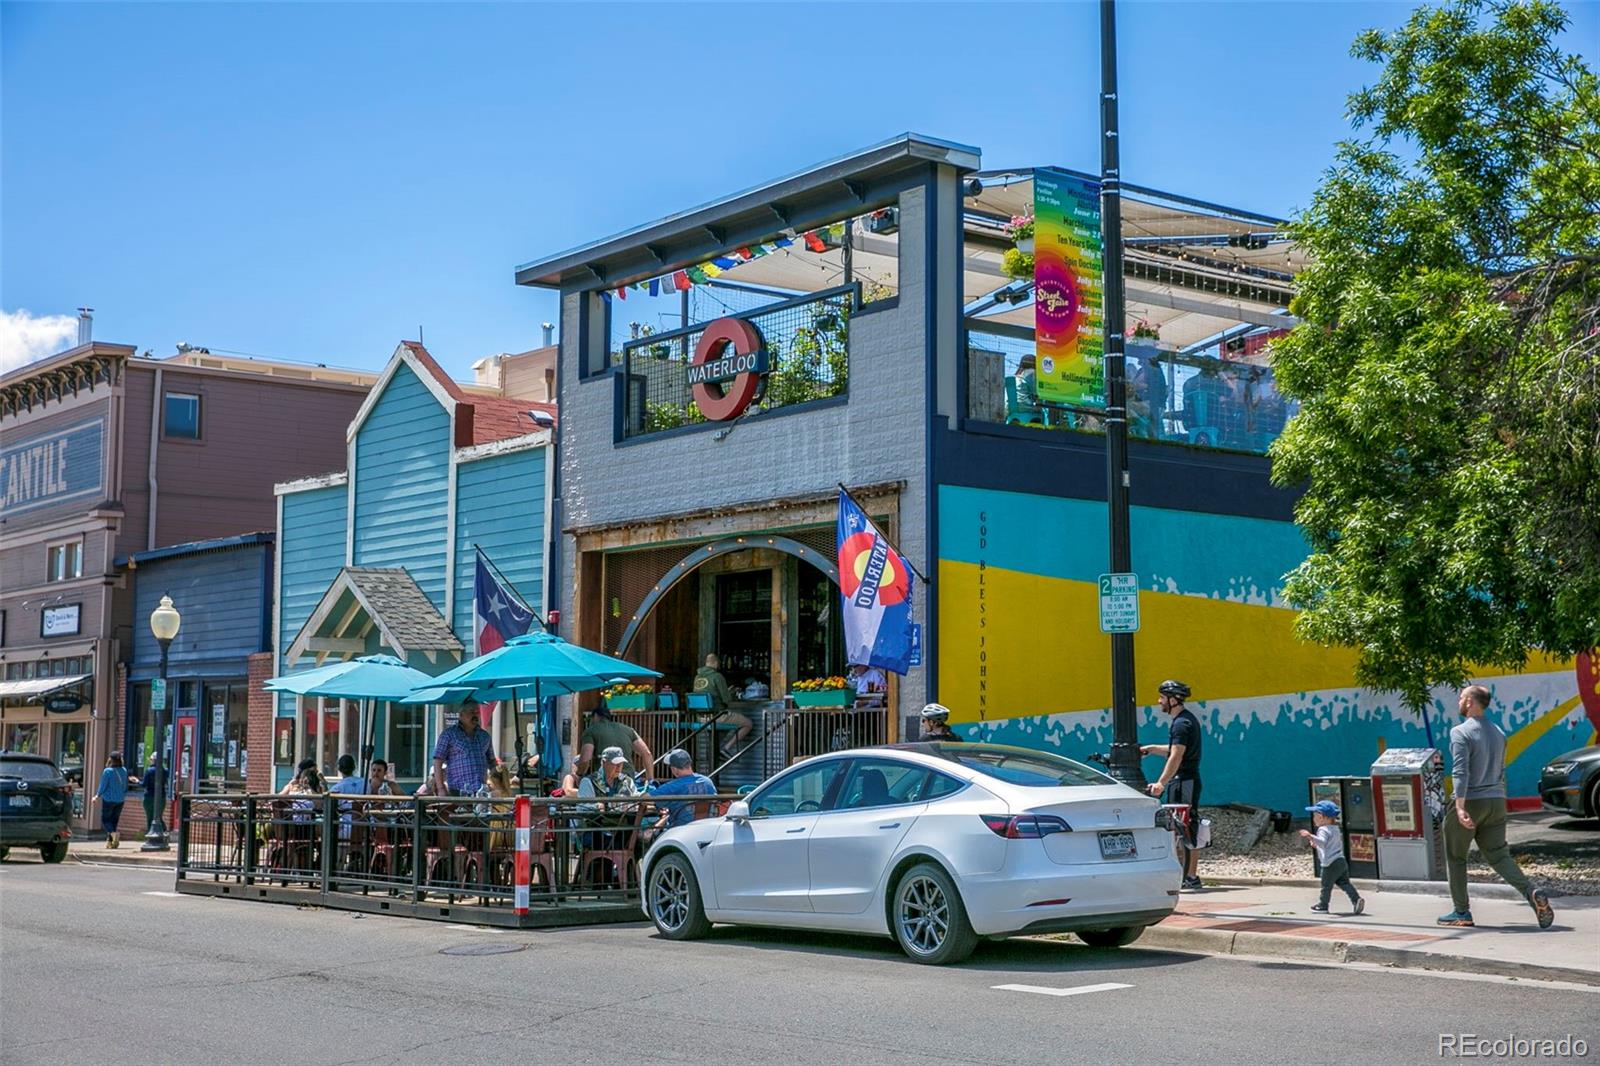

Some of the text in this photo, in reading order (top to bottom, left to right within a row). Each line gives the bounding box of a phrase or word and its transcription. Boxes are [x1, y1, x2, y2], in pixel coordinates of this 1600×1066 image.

[1073, 207, 1090, 218] June
[1057, 234, 1069, 245] Ten
[1068, 236, 1085, 249] Years
[1037, 289, 1063, 302] Street
[1047, 299, 1069, 312] Faire
[688, 354, 756, 384] WATERLOO
[979, 512, 987, 549] GOD
[1101, 579, 1110, 594] 2
[979, 636, 987, 721] JOHNNY
